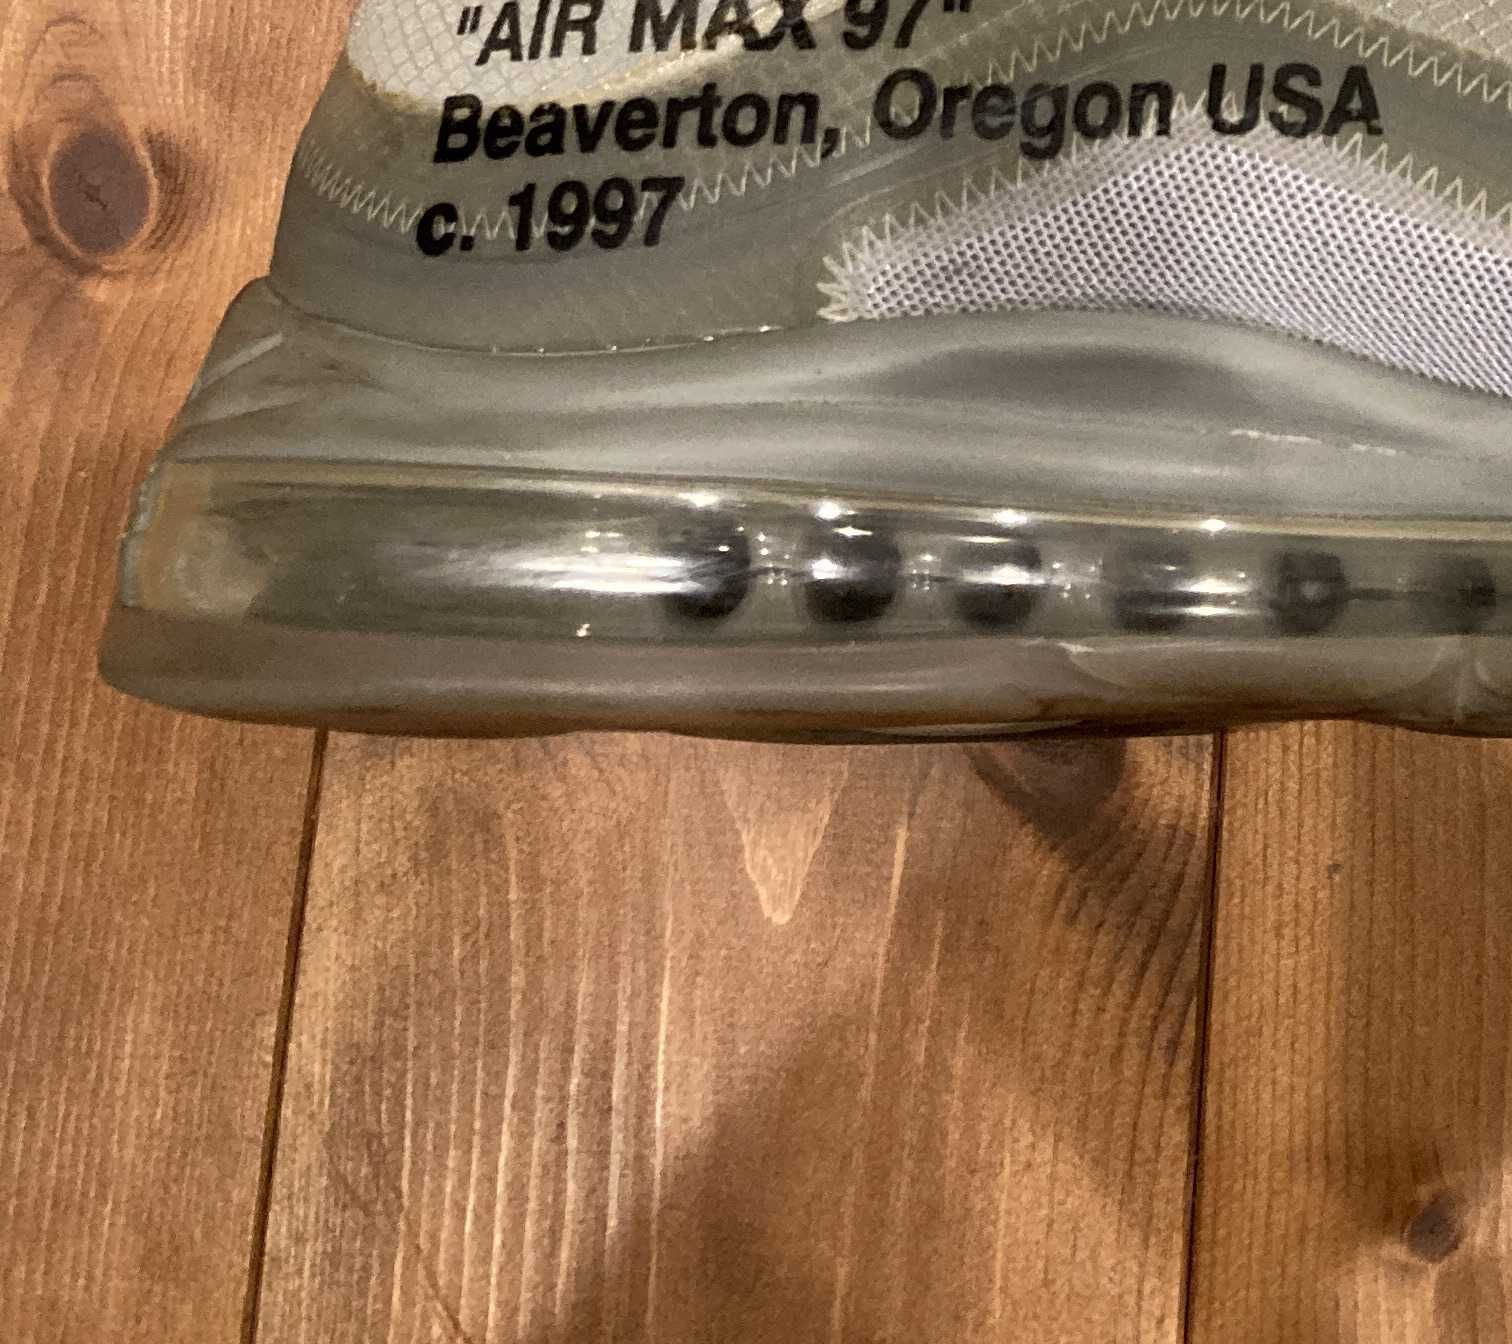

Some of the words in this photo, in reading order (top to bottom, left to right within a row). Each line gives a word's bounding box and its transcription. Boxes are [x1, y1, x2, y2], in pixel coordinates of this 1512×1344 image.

[432, 81, 841, 164] Beaverton,
[873, 67, 1175, 161] Oregon
[1207, 62, 1384, 140] USA
[415, 202, 475, 258] c.
[507, 175, 685, 252] 1997
